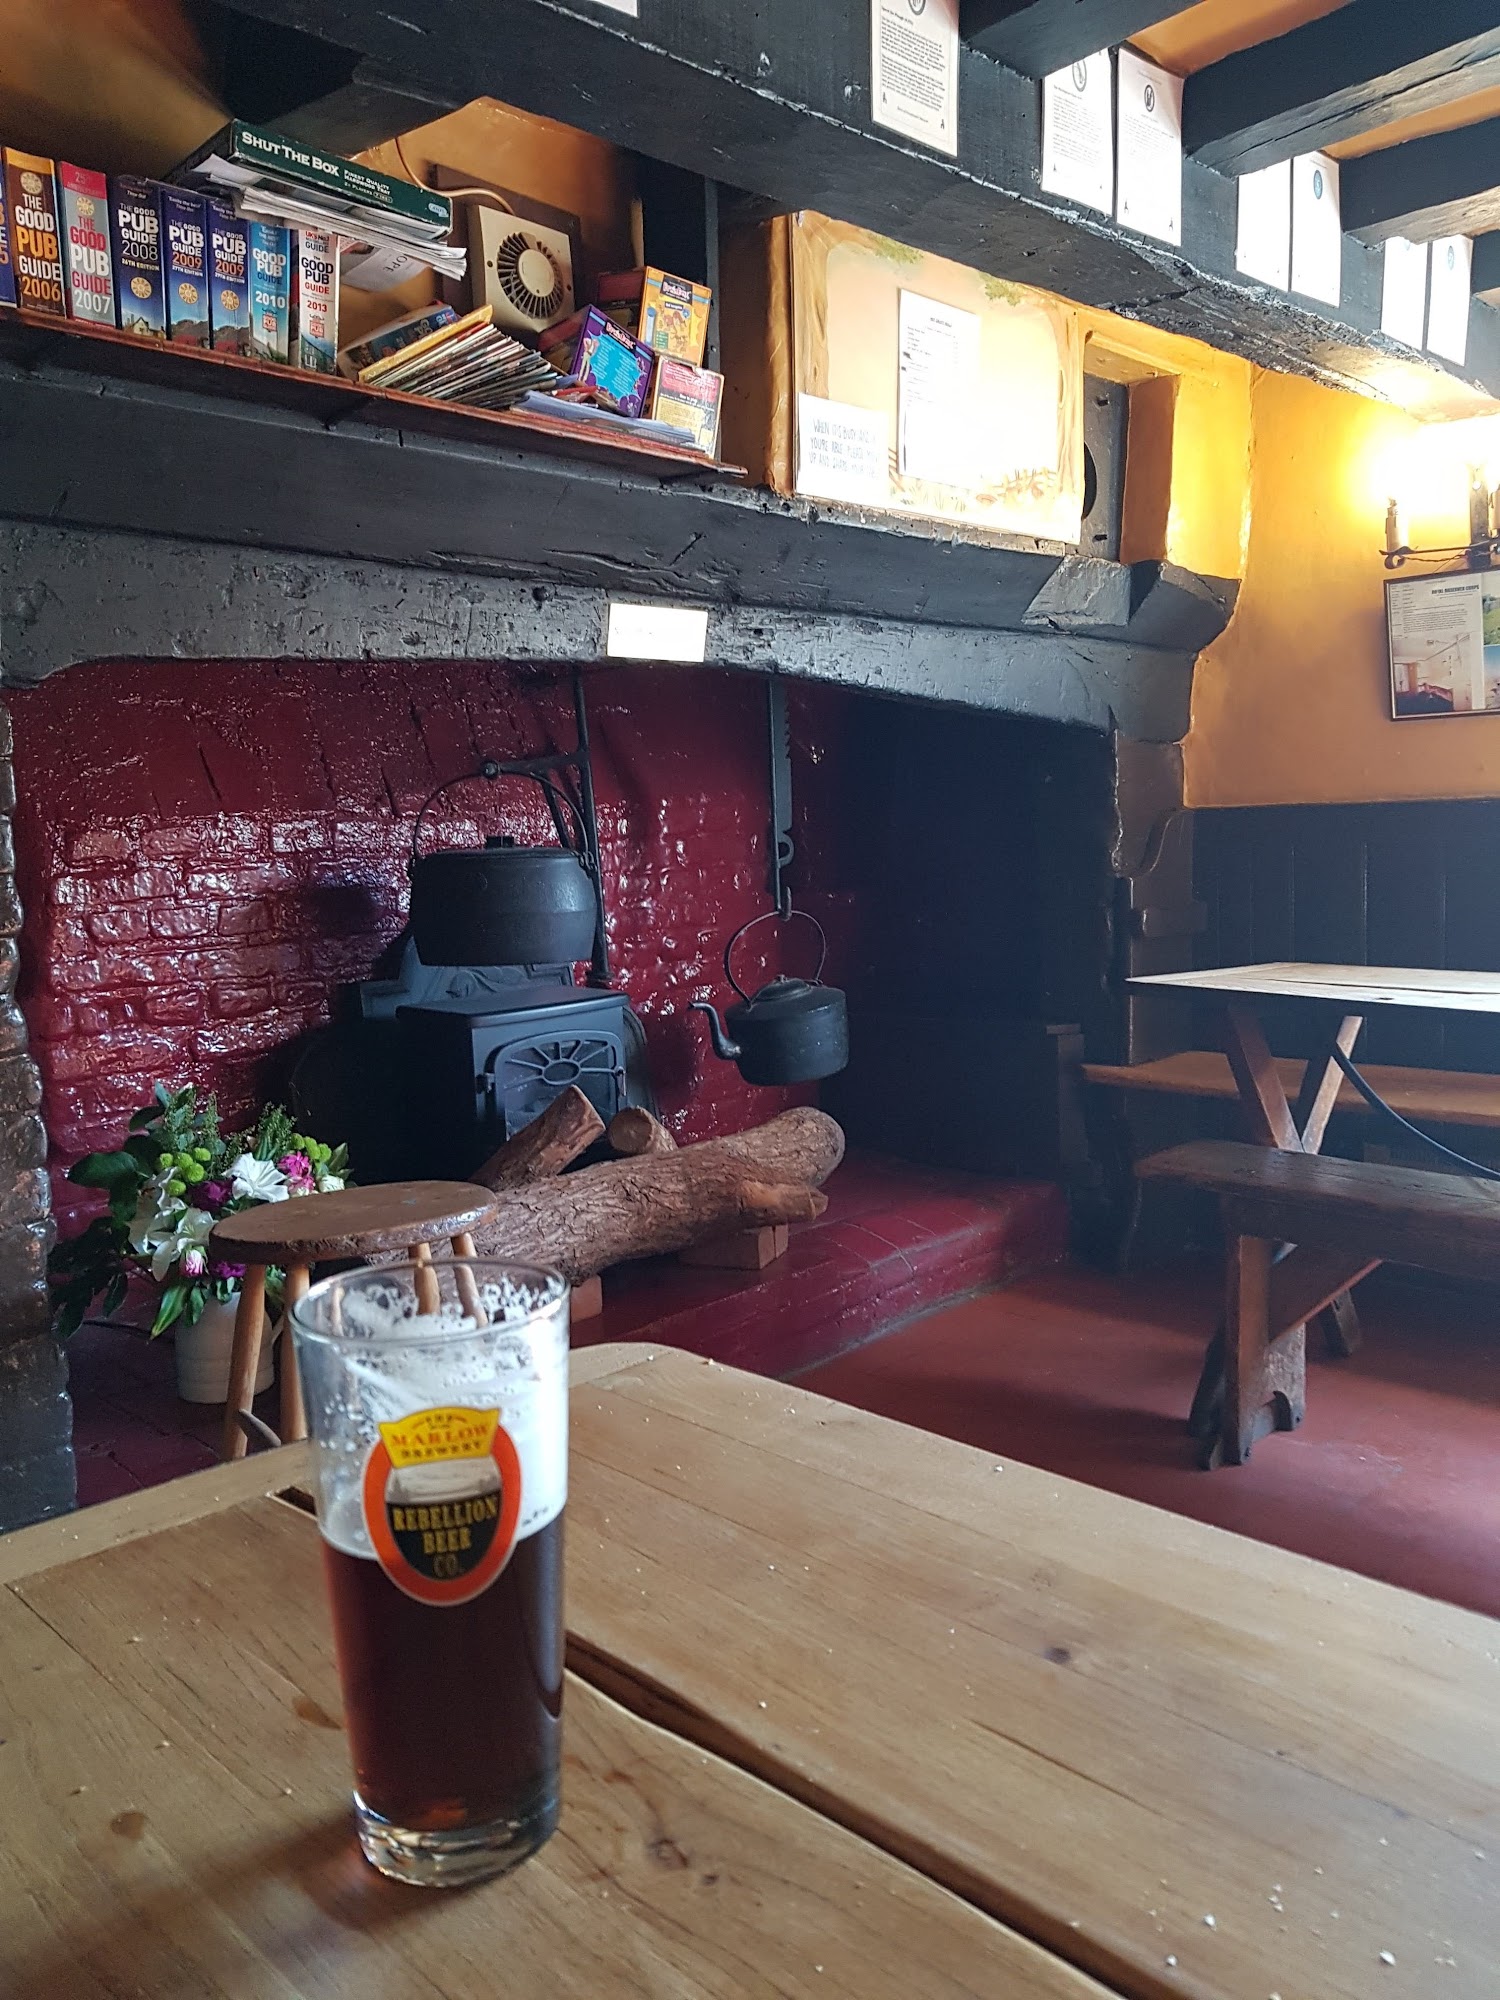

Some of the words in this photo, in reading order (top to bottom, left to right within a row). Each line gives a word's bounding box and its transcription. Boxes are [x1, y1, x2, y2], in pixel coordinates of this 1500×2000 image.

[242, 132, 280, 154] SHUT
[281, 144, 310, 166] THE
[312, 156, 340, 177] BOX
[344, 169, 364, 181] FINEST
[366, 178, 389, 190] QUALITY
[344, 176, 375, 190] HARDWOOD
[377, 186, 390, 195] TRAY
[22, 194, 42, 210] THE
[120, 202, 133, 212] THE
[133, 206, 155, 216] GOOD
[15, 206, 54, 231] GOOD
[78, 216, 95, 232] THE
[118, 209, 159, 234] PUB
[171, 219, 182, 228] THE
[184, 223, 200, 232] GOOD
[16, 225, 58, 260] PUB
[70, 226, 106, 251] GOOD
[121, 228, 157, 245] GUIDE
[169, 224, 204, 248] PUB
[214, 228, 226, 236] THE
[226, 232, 243, 240] GOOD
[121, 240, 158, 260] 2008
[172, 242, 202, 257] GUIDE
[212, 233, 246, 256] PUB
[305, 242, 329, 253] GUIDE
[70, 244, 109, 276] PUB
[172, 251, 202, 269] 2009
[215, 249, 244, 264] GUIDE
[253, 248, 286, 266] GOOD
[302, 257, 334, 274] GOOD
[19, 256, 62, 282] GUIDE
[136, 262, 159, 271] EDITION
[184, 268, 203, 277] EDITION
[215, 259, 244, 277] 2009
[257, 260, 282, 278] PUB
[72, 271, 112, 296] GUIDE
[226, 275, 245, 284] EDITION
[257, 272, 282, 284] GUIDE
[305, 269, 329, 284] PUB
[22, 276, 61, 302] 2006
[305, 282, 330, 294] GUIDE
[74, 290, 111, 314] 2007
[255, 290, 285, 308] 2010
[307, 300, 327, 312] 2013
[813, 418, 829, 435] WHEN
[843, 426, 856, 440] BUSY
[810, 437, 828, 452] YOU'RE
[809, 452, 817, 464] UP
[392, 1425, 488, 1446] MARLOW
[402, 1441, 480, 1458] BREWERY
[393, 1496, 498, 1530] REBELLION
[423, 1527, 471, 1554] BEER
